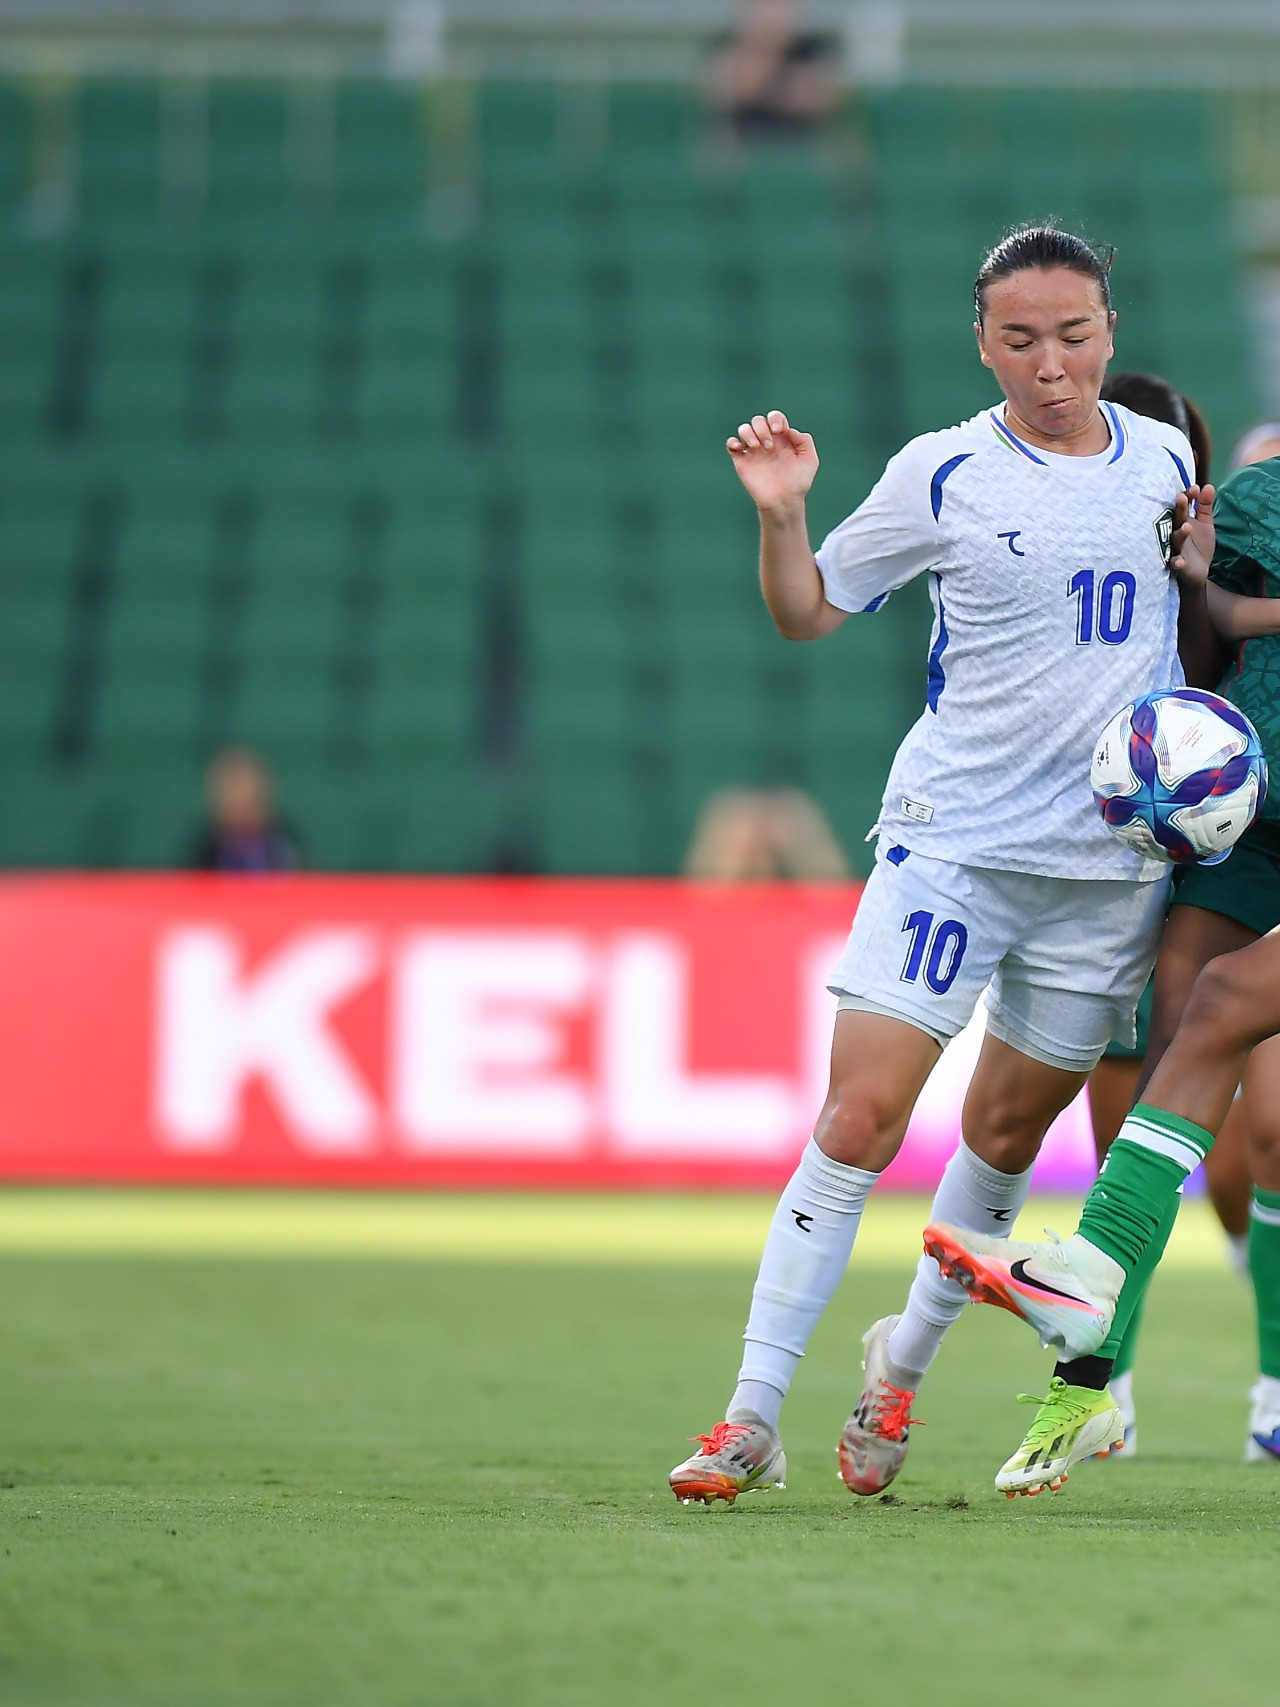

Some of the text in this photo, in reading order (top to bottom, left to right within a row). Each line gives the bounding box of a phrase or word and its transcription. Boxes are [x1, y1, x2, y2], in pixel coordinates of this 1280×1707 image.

[1066, 569, 1136, 645] 10
[899, 909, 968, 995] 10
[156, 924, 852, 1156] KEL
